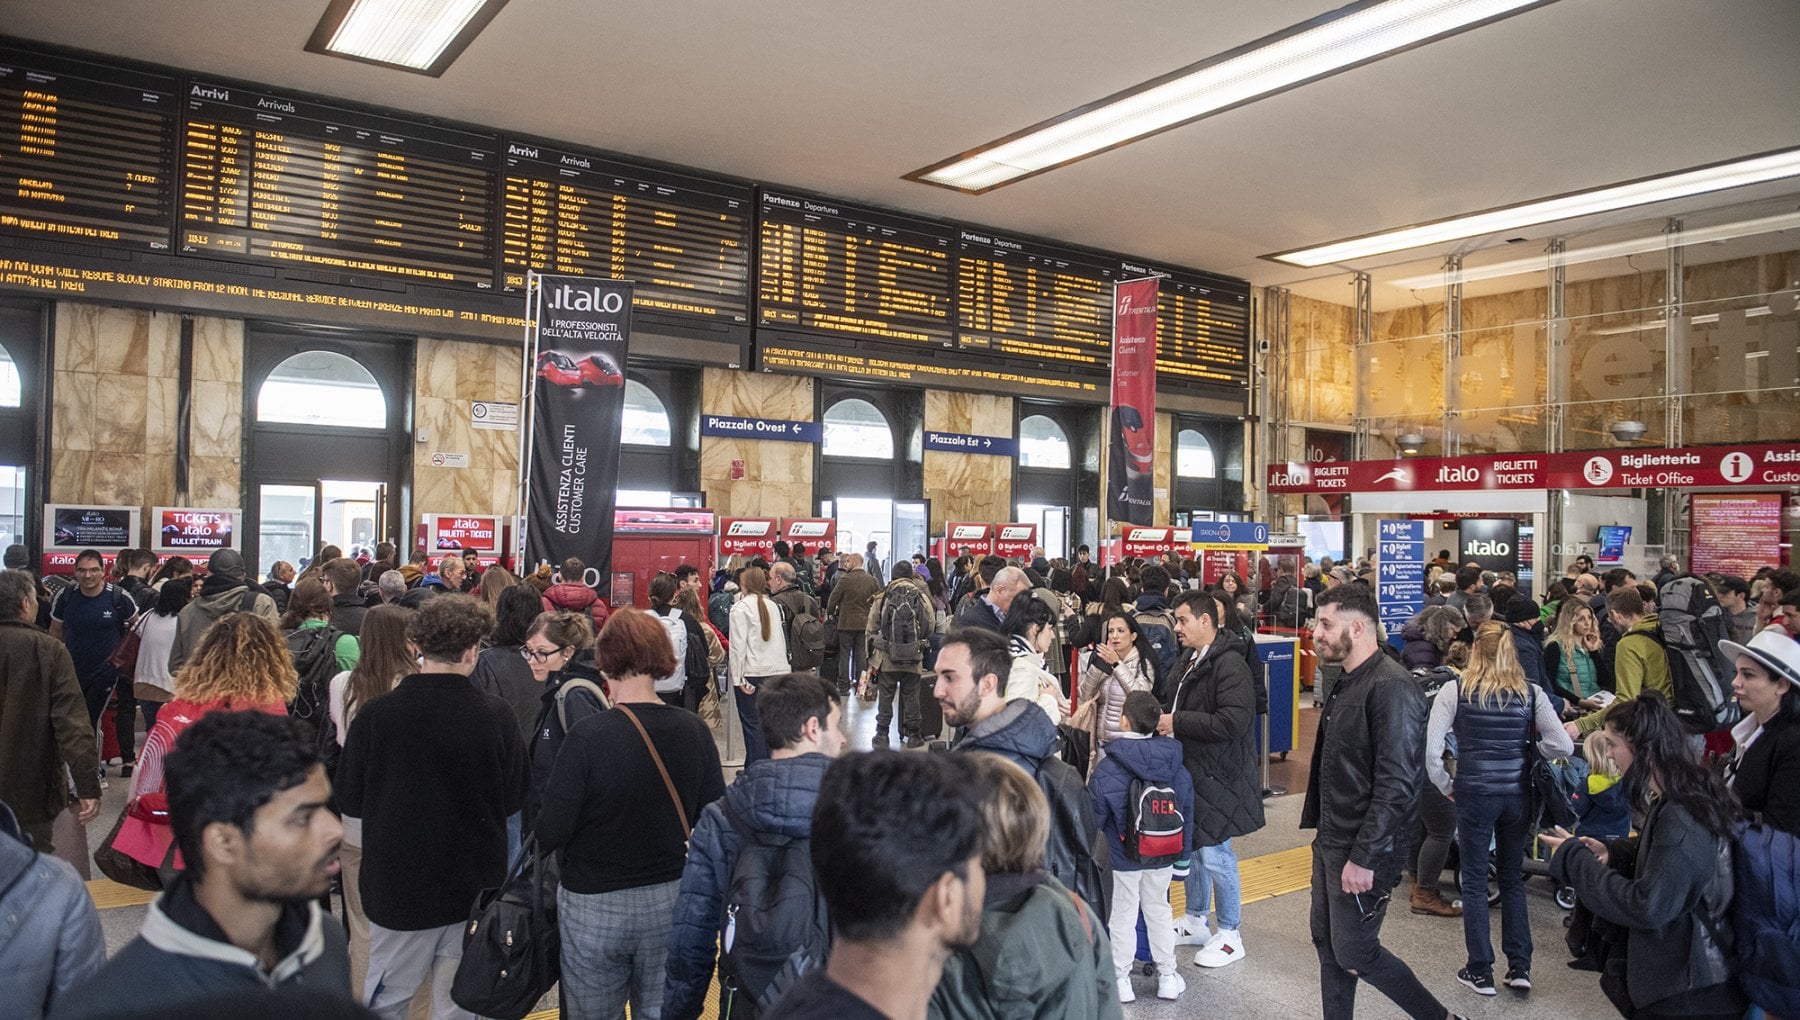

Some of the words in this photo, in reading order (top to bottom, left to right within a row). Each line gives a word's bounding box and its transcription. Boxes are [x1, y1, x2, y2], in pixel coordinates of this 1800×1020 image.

[191, 85, 229, 101] Arrivi
[257, 97, 296, 113] Arrivals
[508, 144, 539, 159] Arrivi
[560, 155, 591, 169] Arrivals
[763, 193, 800, 208] Partenze
[804, 201, 839, 215] Departures
[961, 231, 991, 245] Partenze
[993, 238, 1022, 250] Departures
[1121, 262, 1147, 274] Partenze
[116, 273, 150, 287] SLOWLY
[153, 277, 191, 290] STARTING
[193, 281, 214, 292] FROM
[215, 284, 226, 293] 12
[550, 319, 555, 328] I
[555, 319, 618, 332] PROFESSIONISTI
[542, 327, 583, 340] DELL'ALTA
[1118, 346, 1136, 354] Clienti
[708, 417, 754, 431] Piazzale
[756, 421, 786, 433] Ovest
[561, 424, 576, 467] CLIENTI
[929, 434, 966, 446] Piazzale
[966, 437, 979, 447] Est
[574, 447, 588, 475] CARE
[1493, 460, 1538, 471] BIGLIETTI
[1621, 453, 1700, 469] Biglietteria
[1314, 466, 1349, 476] BIGLIETTI
[1316, 479, 1347, 488] TICKETS
[1496, 473, 1535, 484] TICKETS
[1621, 473, 1653, 485] Ticket
[1656, 472, 1694, 484] Office
[554, 468, 573, 534] ASSISTENZA
[568, 477, 585, 534] CUSTOMER
[173, 513, 221, 524] TICKETS
[1396, 522, 1412, 531] Biglietti
[438, 529, 465, 538] BIGLIETTI
[470, 530, 492, 538] TICKETS
[733, 540, 757, 549] Biglietti
[1395, 543, 1412, 551] Biglietti
